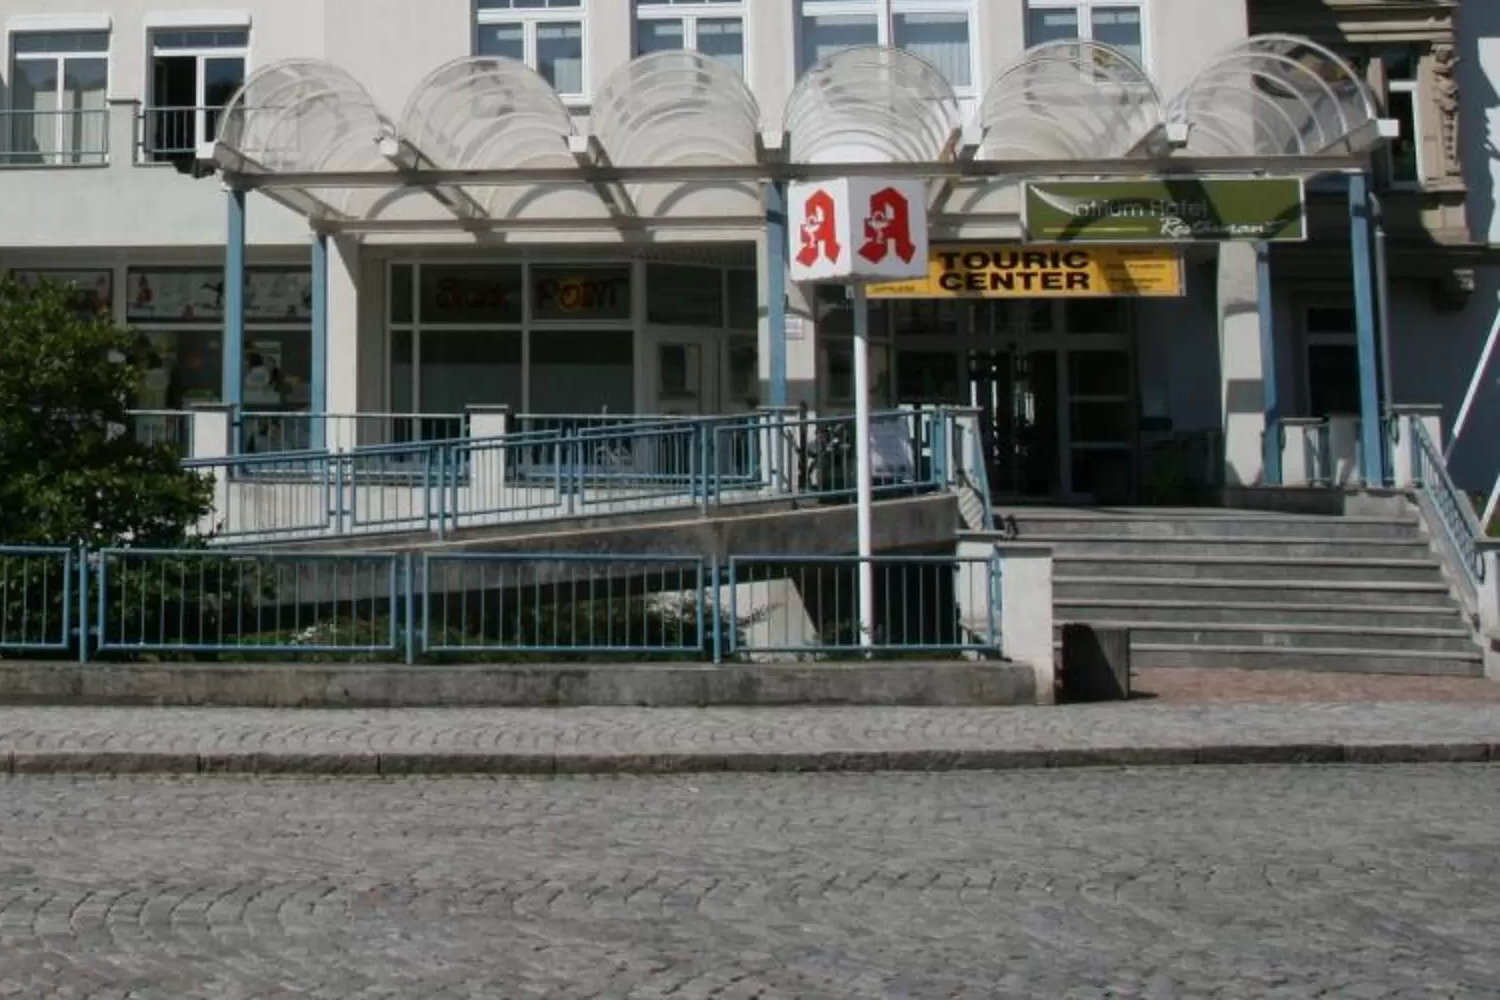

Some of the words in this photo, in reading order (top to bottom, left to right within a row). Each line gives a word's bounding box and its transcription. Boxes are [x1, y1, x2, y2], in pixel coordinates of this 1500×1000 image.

[1150, 199, 1207, 217] Hotel
[937, 250, 1089, 271] TOURIC
[937, 271, 1090, 292] CENTER
